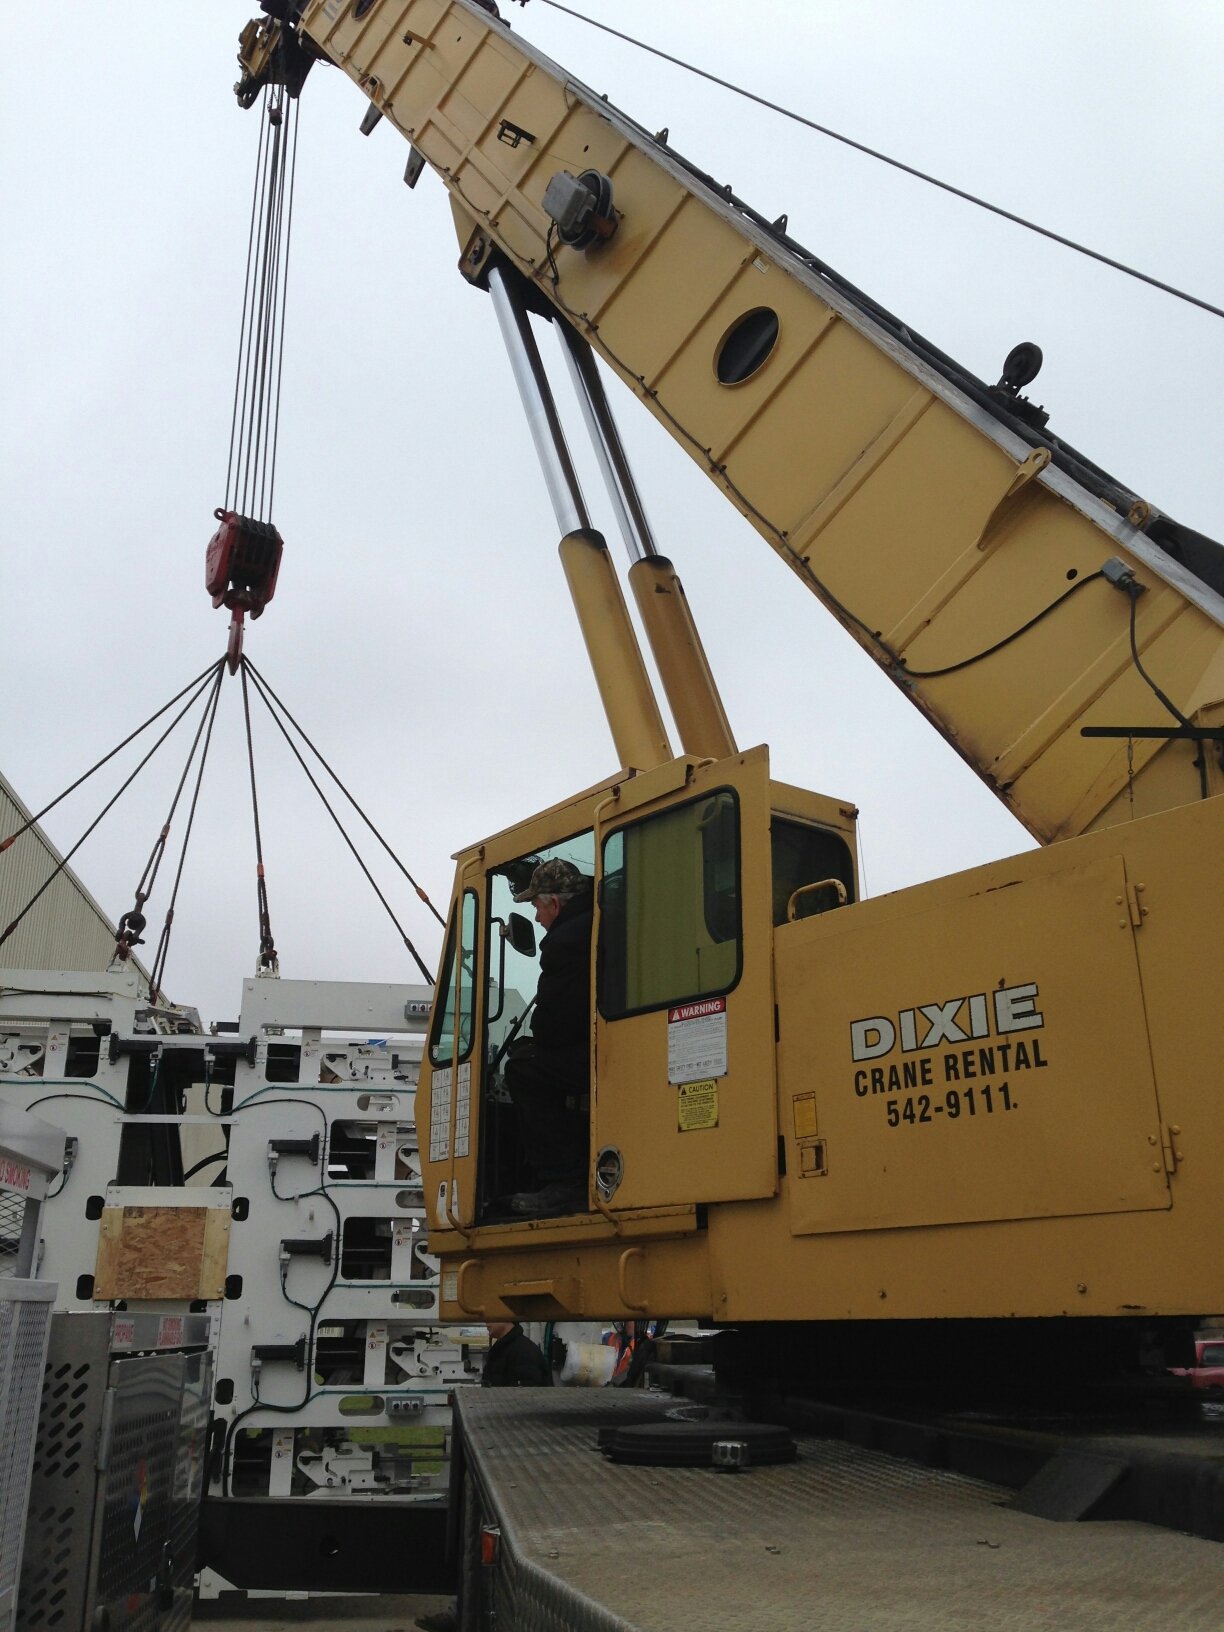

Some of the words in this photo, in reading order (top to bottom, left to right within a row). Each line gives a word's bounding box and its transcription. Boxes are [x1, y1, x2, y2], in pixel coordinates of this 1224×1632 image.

[681, 1001, 720, 1017] WARNING
[850, 982, 1044, 1063] DIXIE
[854, 1058, 934, 1097] CRANE
[944, 1039, 1048, 1082] RENTAL
[689, 1084, 714, 1093] CAUTION
